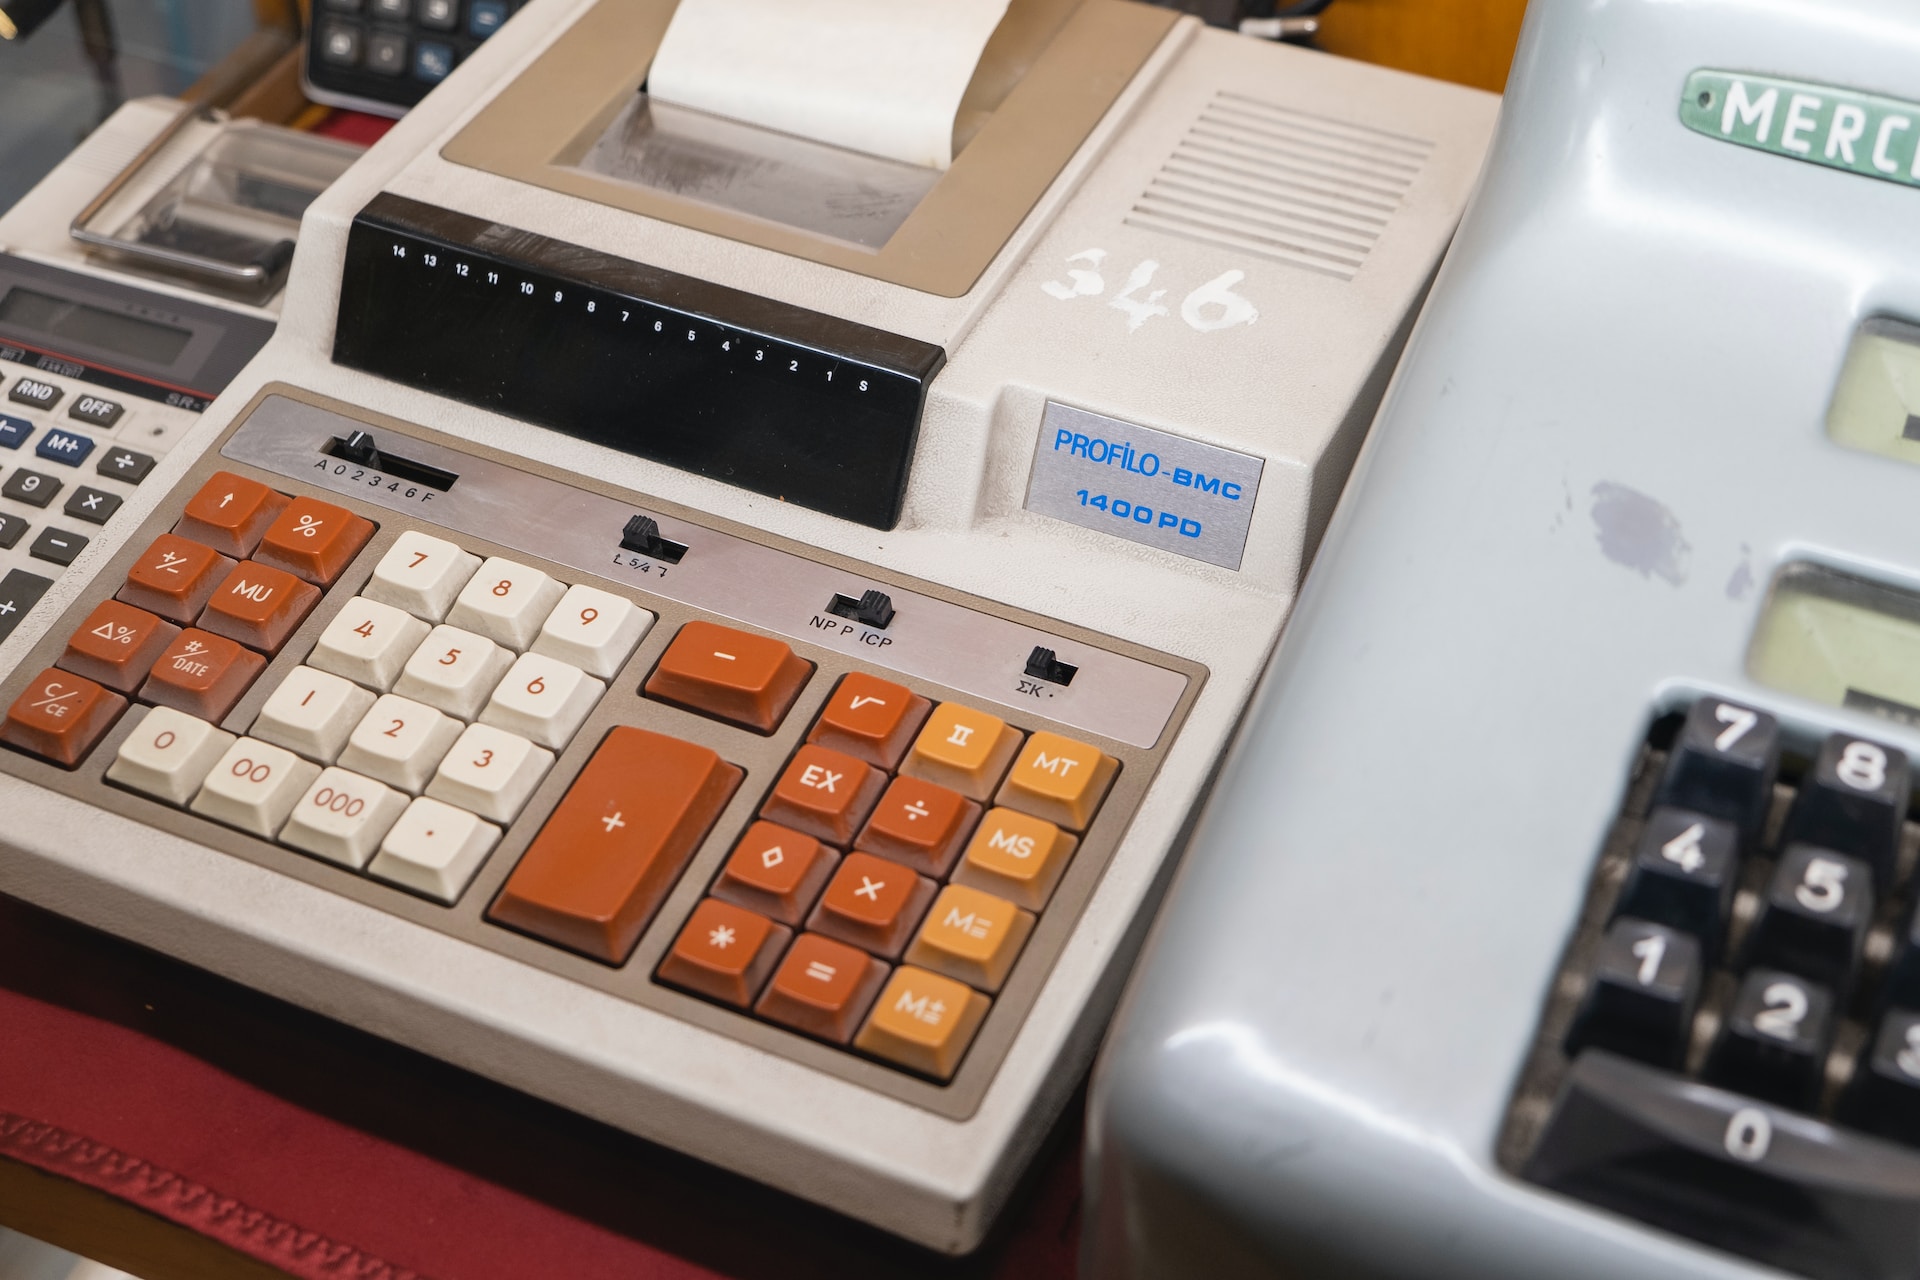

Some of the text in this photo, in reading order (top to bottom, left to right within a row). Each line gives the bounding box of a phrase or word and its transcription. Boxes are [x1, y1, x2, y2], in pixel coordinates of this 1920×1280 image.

[1720, 79, 1920, 180] MERC
[1040, 248, 1260, 334] 346
[392, 245, 868, 391] 14 13 12 11 10 9 8 7 6 5 4 3 2 1 S
[16, 379, 54, 400] RND
[79, 398, 114, 417] OFF
[49, 434, 79, 453] M+
[21, 476, 40, 492] 9
[408, 551, 428, 568] 7
[231, 579, 273, 603] MU
[492, 579, 512, 597] 8
[354, 619, 373, 639] 4
[580, 607, 599, 626] 9
[809, 615, 893, 649] NP P ICP
[172, 657, 209, 677] DATE
[439, 648, 462, 667] 5
[526, 676, 545, 695] 6
[154, 730, 176, 750] 0
[383, 719, 404, 738] 2
[1714, 703, 1757, 752] 7
[232, 758, 270, 783] 00
[473, 749, 495, 768] 3
[1032, 751, 1079, 777] MT
[1836, 740, 1887, 792] 8
[799, 764, 843, 793] EX
[314, 787, 365, 817] 000
[988, 828, 1036, 859] MS
[1661, 822, 1705, 873] 4
[1795, 857, 1847, 913] 5
[1632, 934, 1666, 986] 1
[1753, 982, 1808, 1041] 2
[1724, 1107, 1772, 1163] 0
